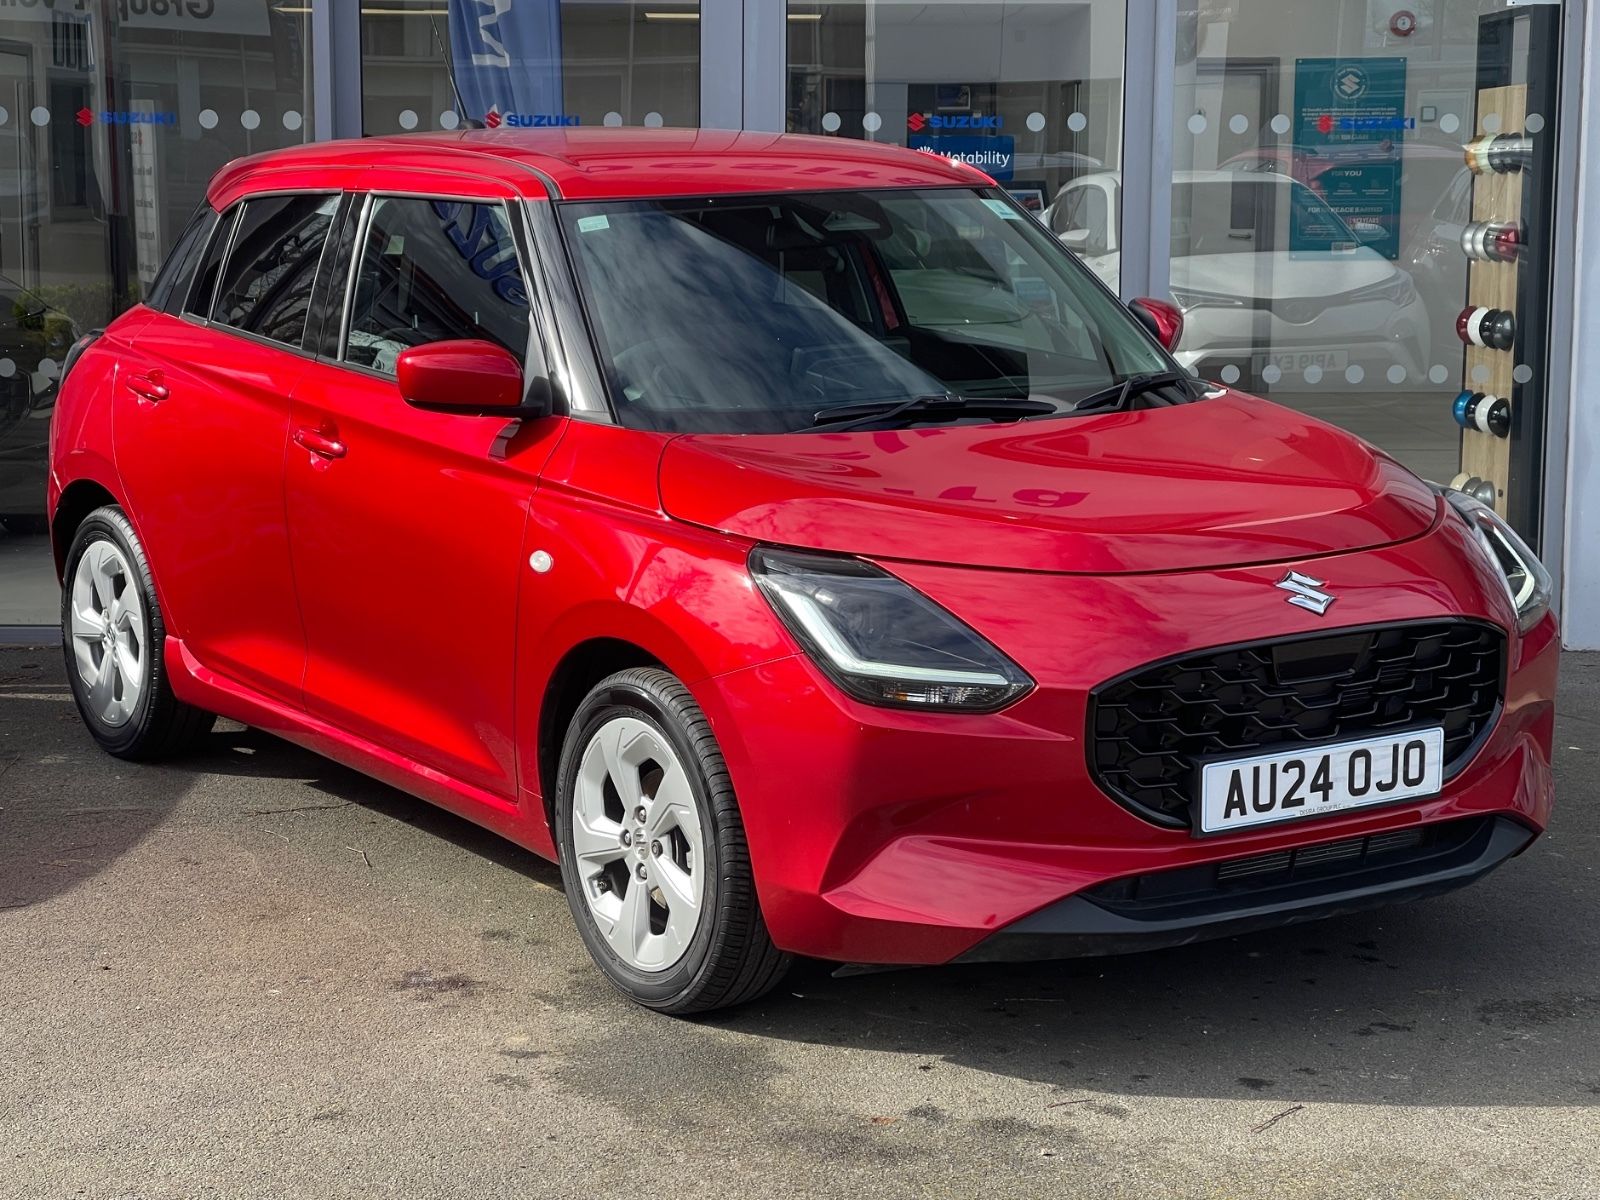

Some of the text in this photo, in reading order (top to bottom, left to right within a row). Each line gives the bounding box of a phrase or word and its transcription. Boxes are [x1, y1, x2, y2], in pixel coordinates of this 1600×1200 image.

[101, 112, 176, 125] SUZUKI
[506, 114, 580, 127] SUZUKI
[929, 115, 1003, 128] SUZUKI
[1224, 739, 1425, 819] AU24 OJO
